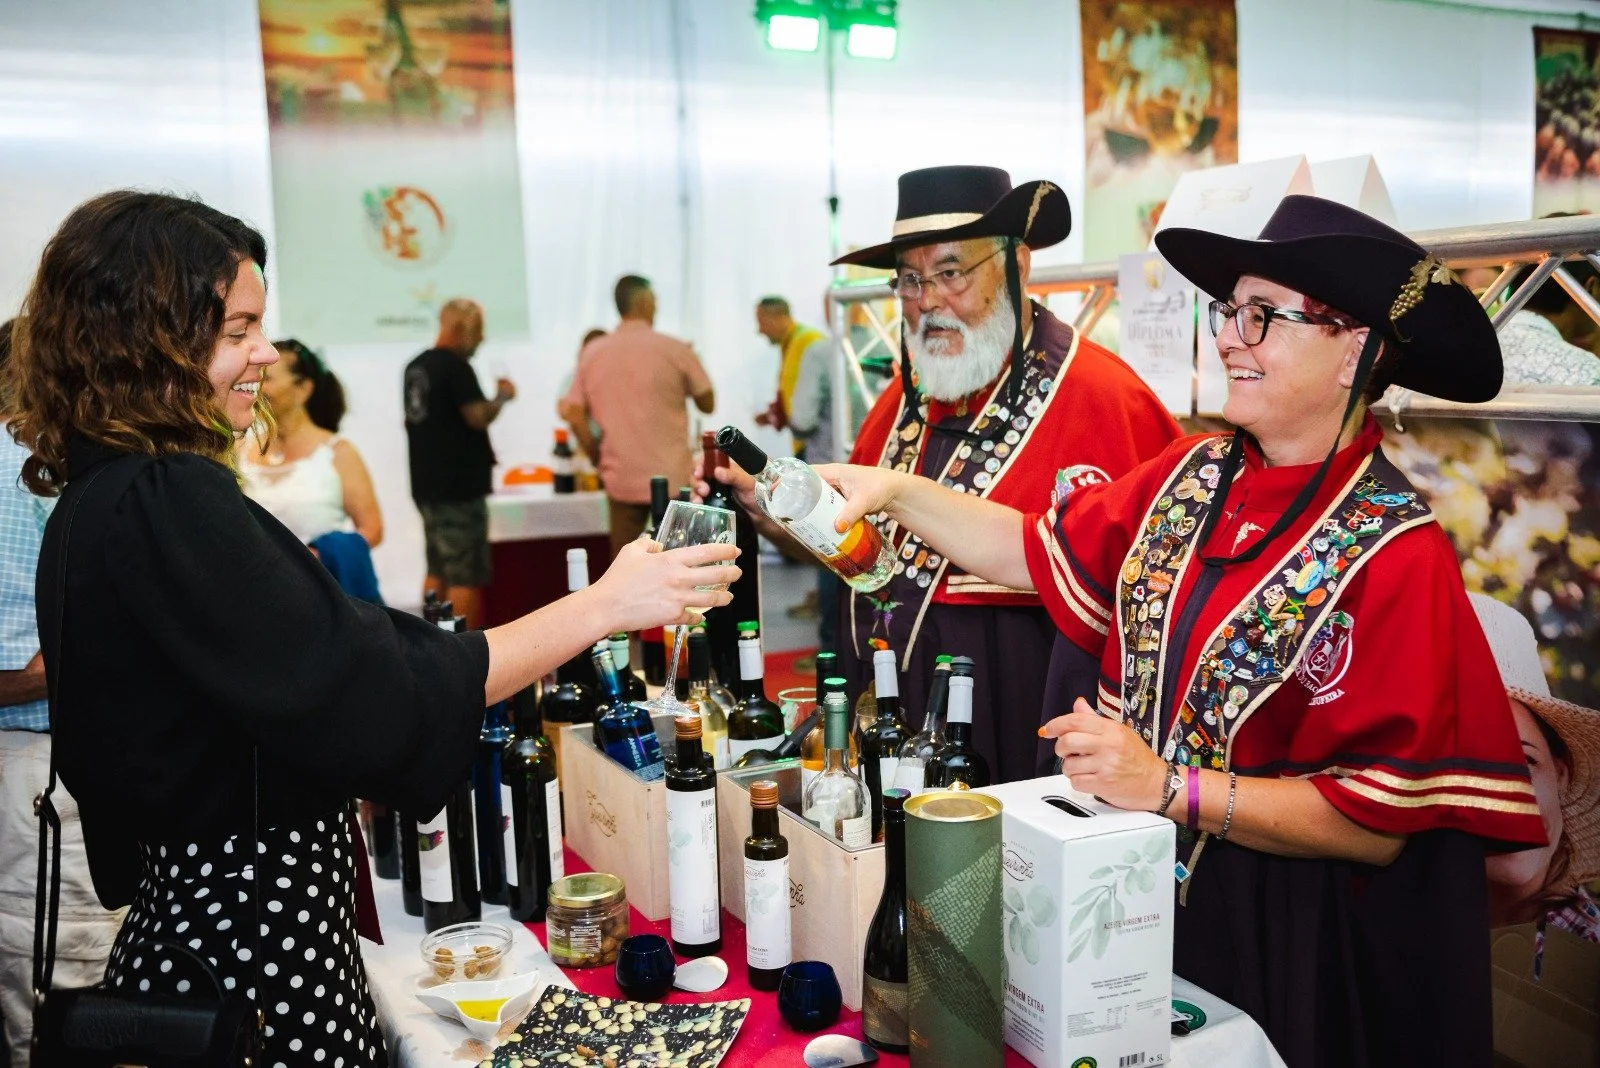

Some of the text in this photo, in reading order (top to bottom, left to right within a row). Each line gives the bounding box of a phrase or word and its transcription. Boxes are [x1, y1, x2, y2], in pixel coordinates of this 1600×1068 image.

[1103, 913, 1160, 930] AZEITE VIRGEM EXTRA
[1008, 981, 1026, 1002] VIRGEM
[1027, 995, 1045, 1014] EXTRA
